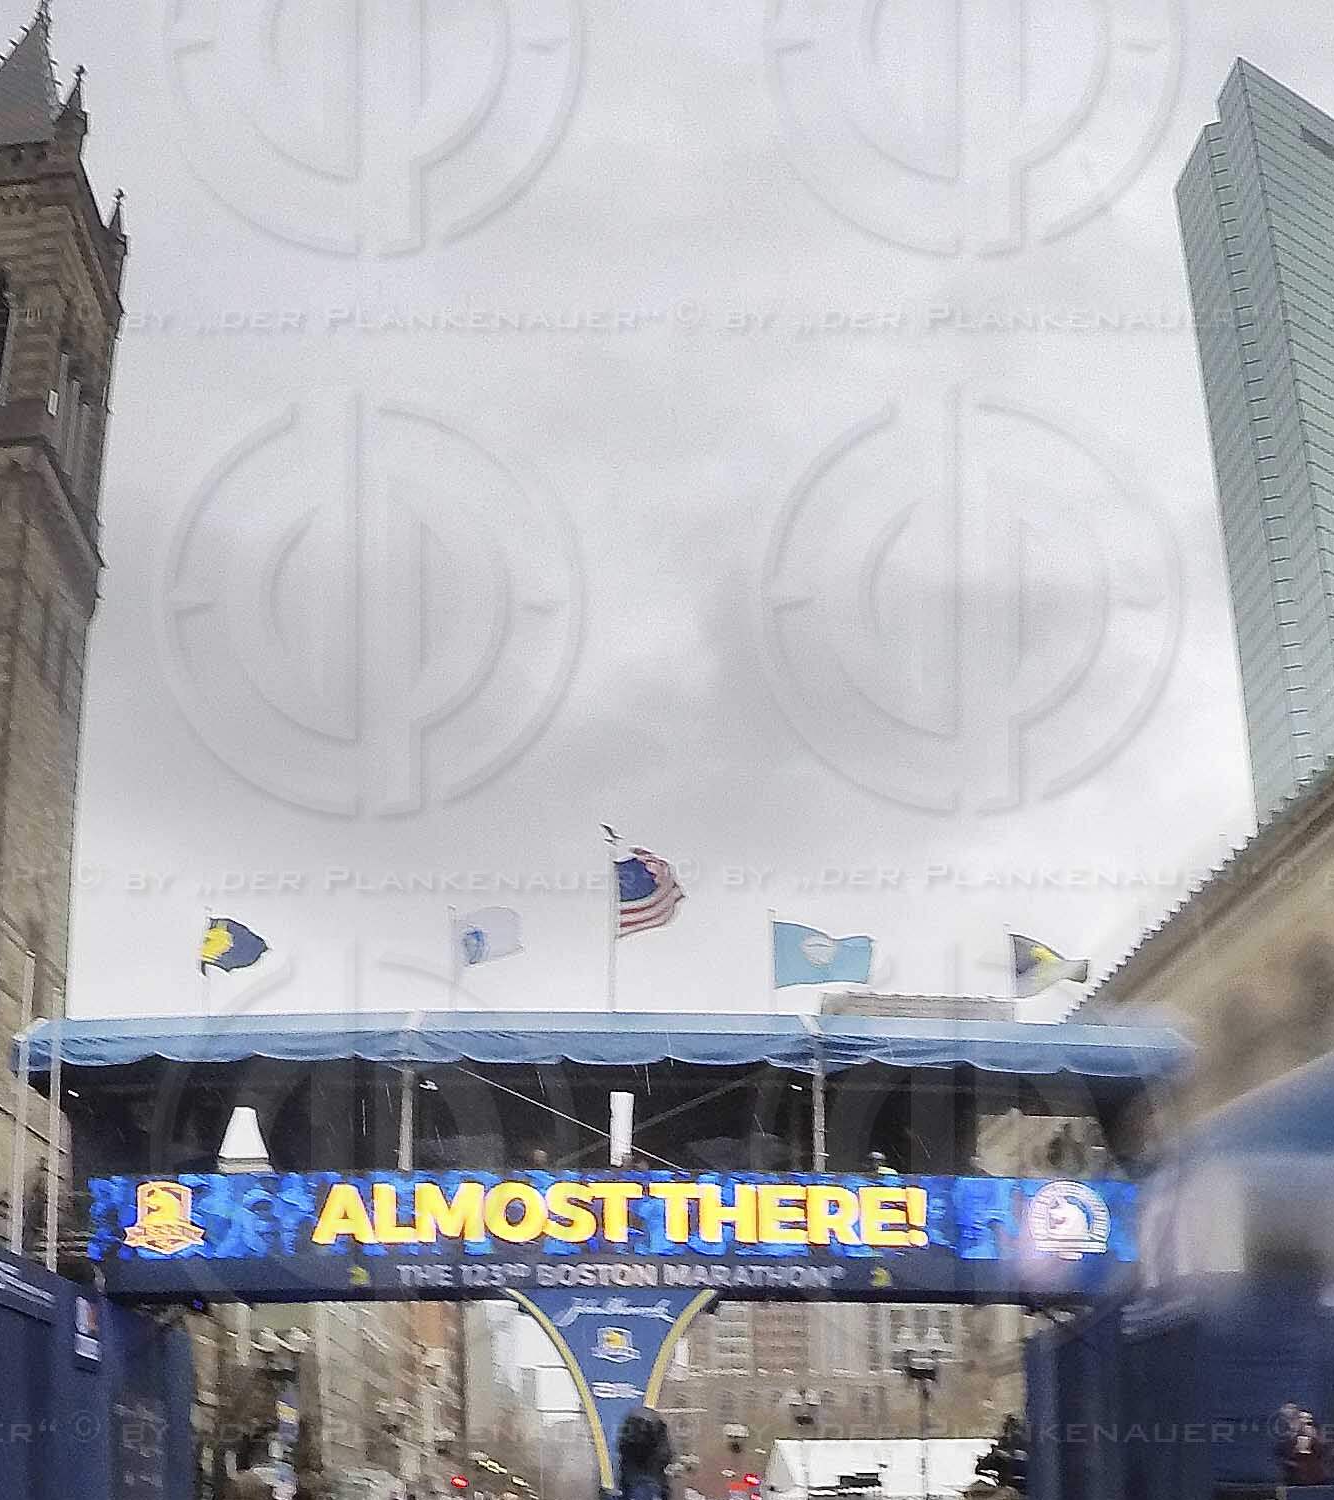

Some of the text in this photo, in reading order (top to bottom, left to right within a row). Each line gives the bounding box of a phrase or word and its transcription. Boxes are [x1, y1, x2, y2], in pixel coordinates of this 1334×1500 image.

[311, 1180, 930, 1249] ALMOST THERE!
[395, 1264, 453, 1287] THE
[535, 1263, 659, 1288] BOSTON
